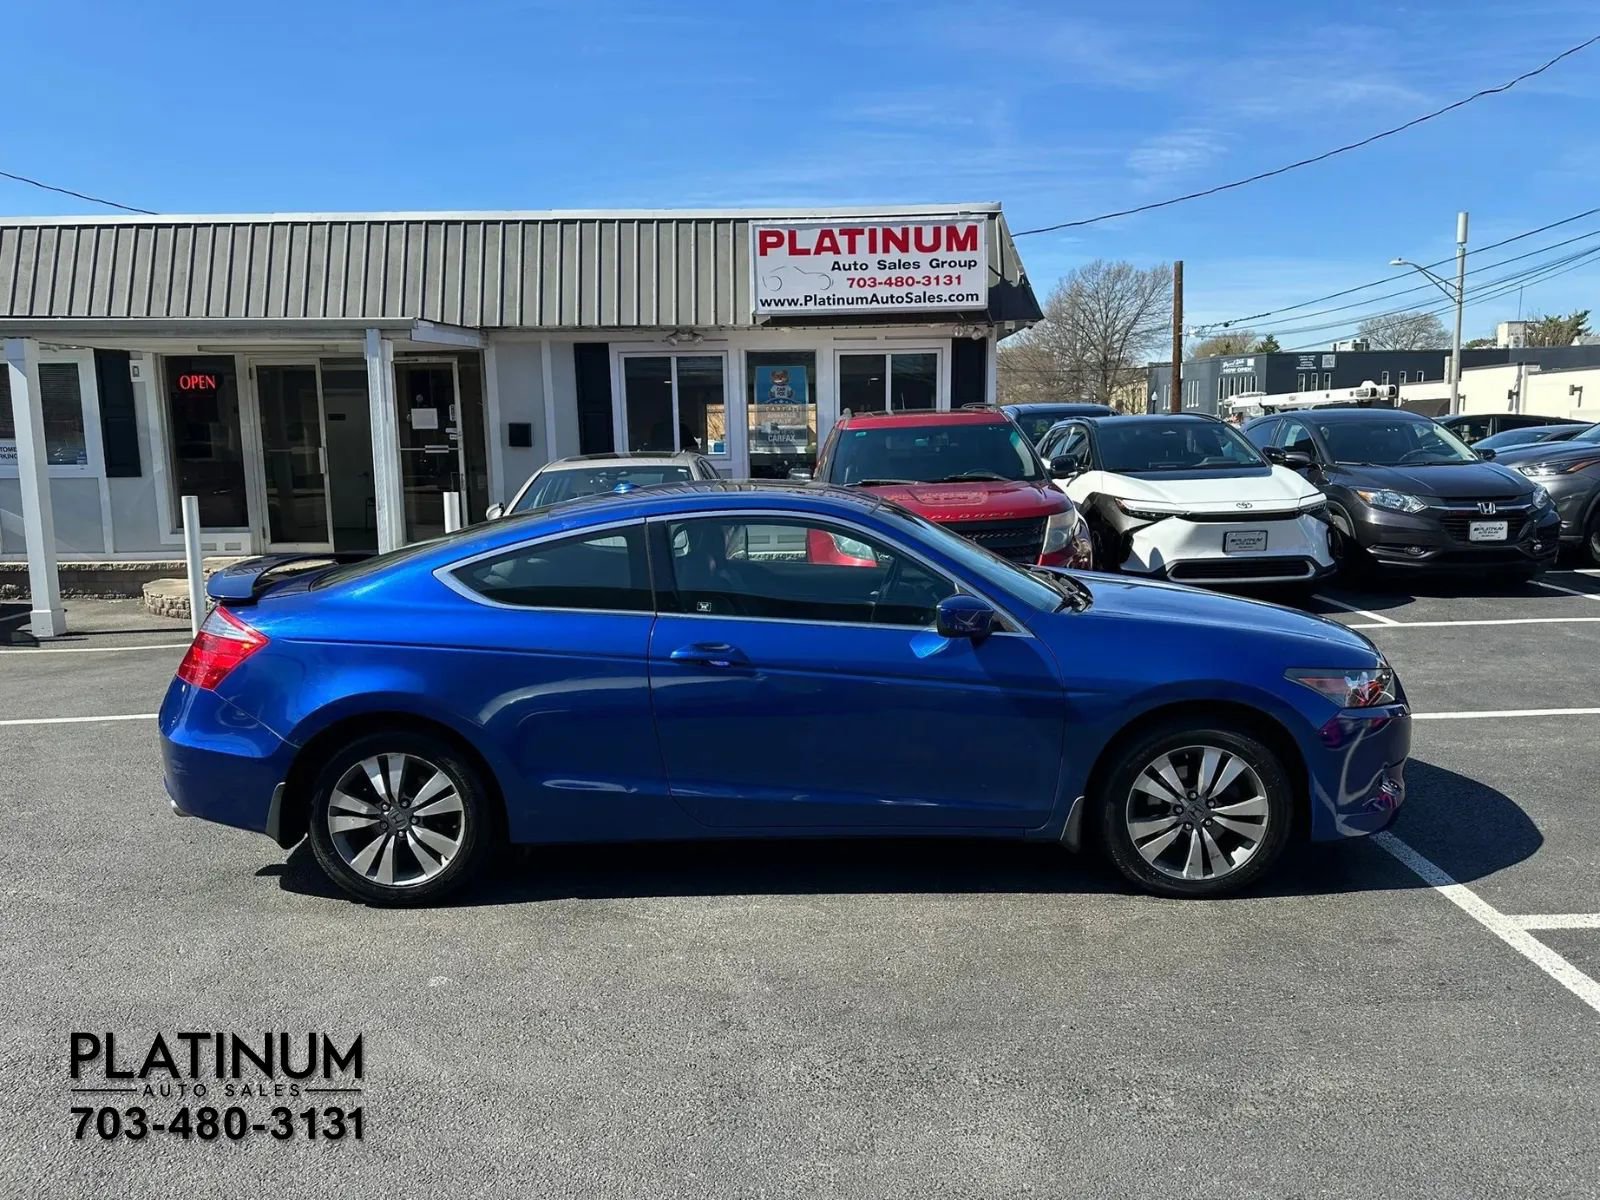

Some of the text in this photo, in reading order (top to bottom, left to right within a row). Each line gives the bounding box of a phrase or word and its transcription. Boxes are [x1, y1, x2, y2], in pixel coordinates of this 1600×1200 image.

[758, 224, 979, 257] PLATINUM
[831, 258, 979, 272] Auto Sales Group
[846, 274, 963, 289] 703-480-3131
[759, 291, 979, 307] www.PlatinumAutoSales.com
[179, 374, 216, 390] OPEN
